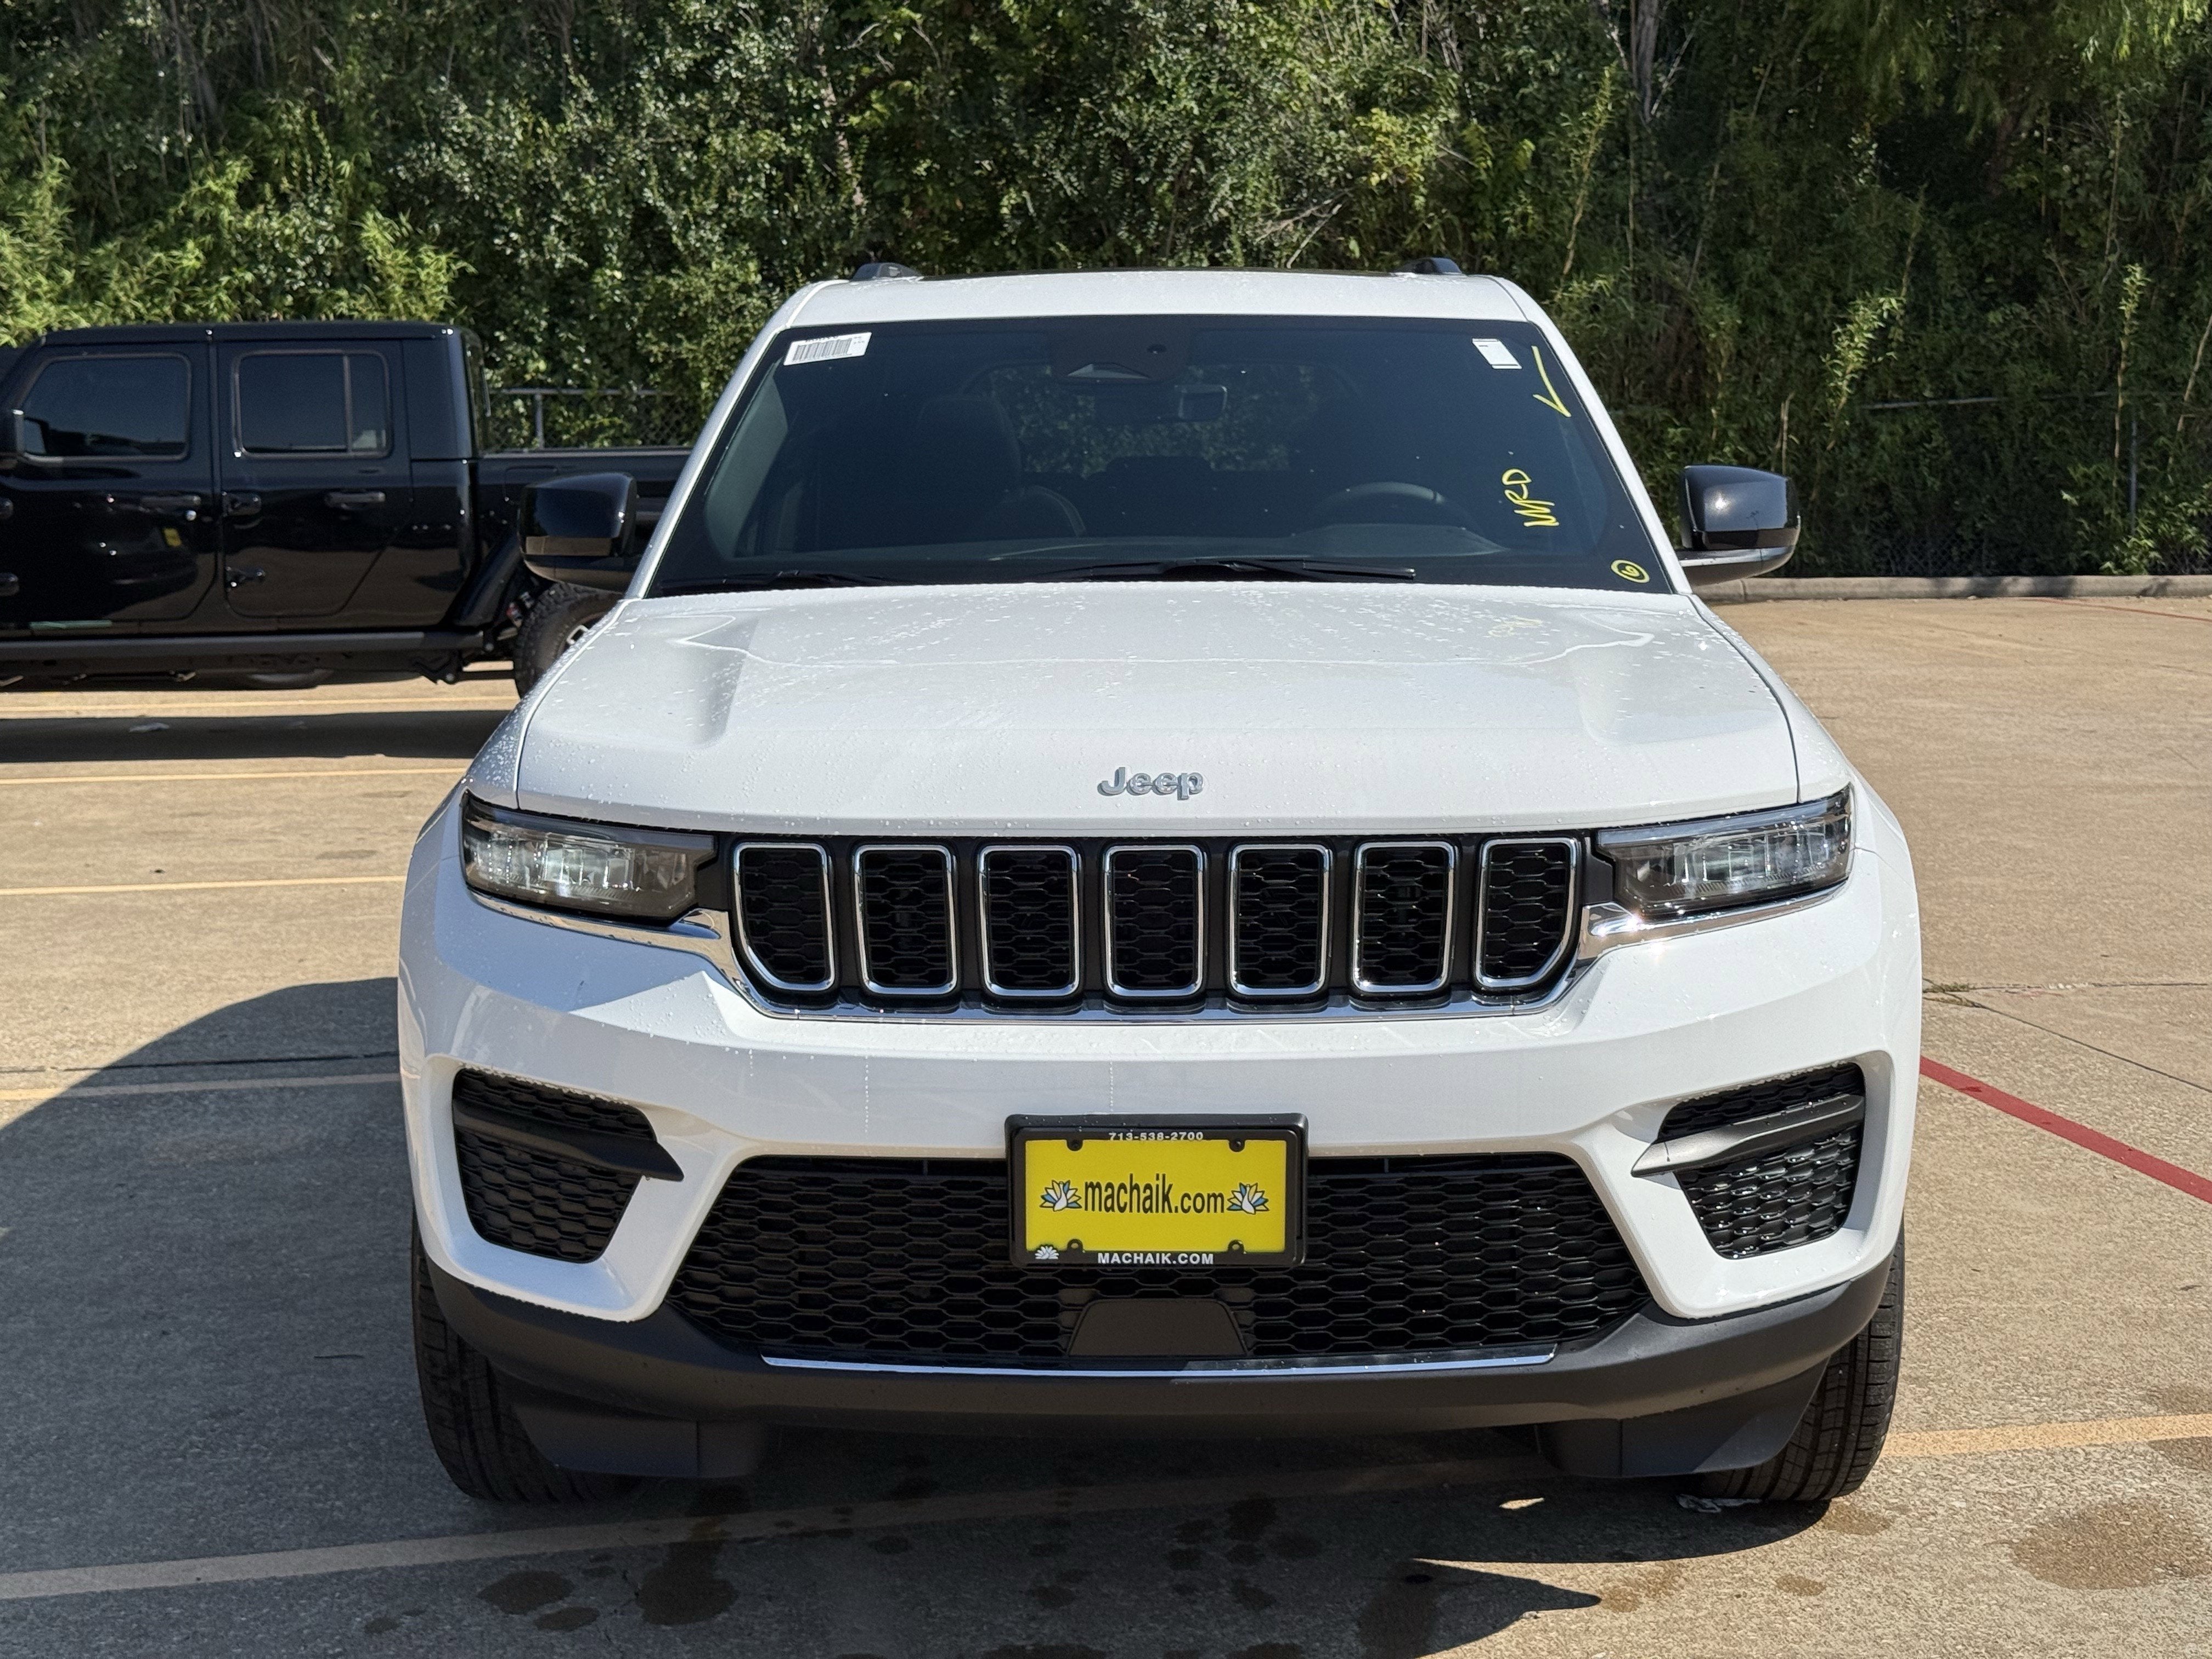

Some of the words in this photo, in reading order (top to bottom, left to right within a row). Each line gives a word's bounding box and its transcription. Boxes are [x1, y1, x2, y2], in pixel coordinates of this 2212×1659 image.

[1097, 767, 1204, 800] Jeep
[1109, 1132, 1204, 1141] 713-538-2700
[1084, 1173, 1224, 1214] machaik.com
[1098, 1253, 1214, 1265] MACHAIK.COM
